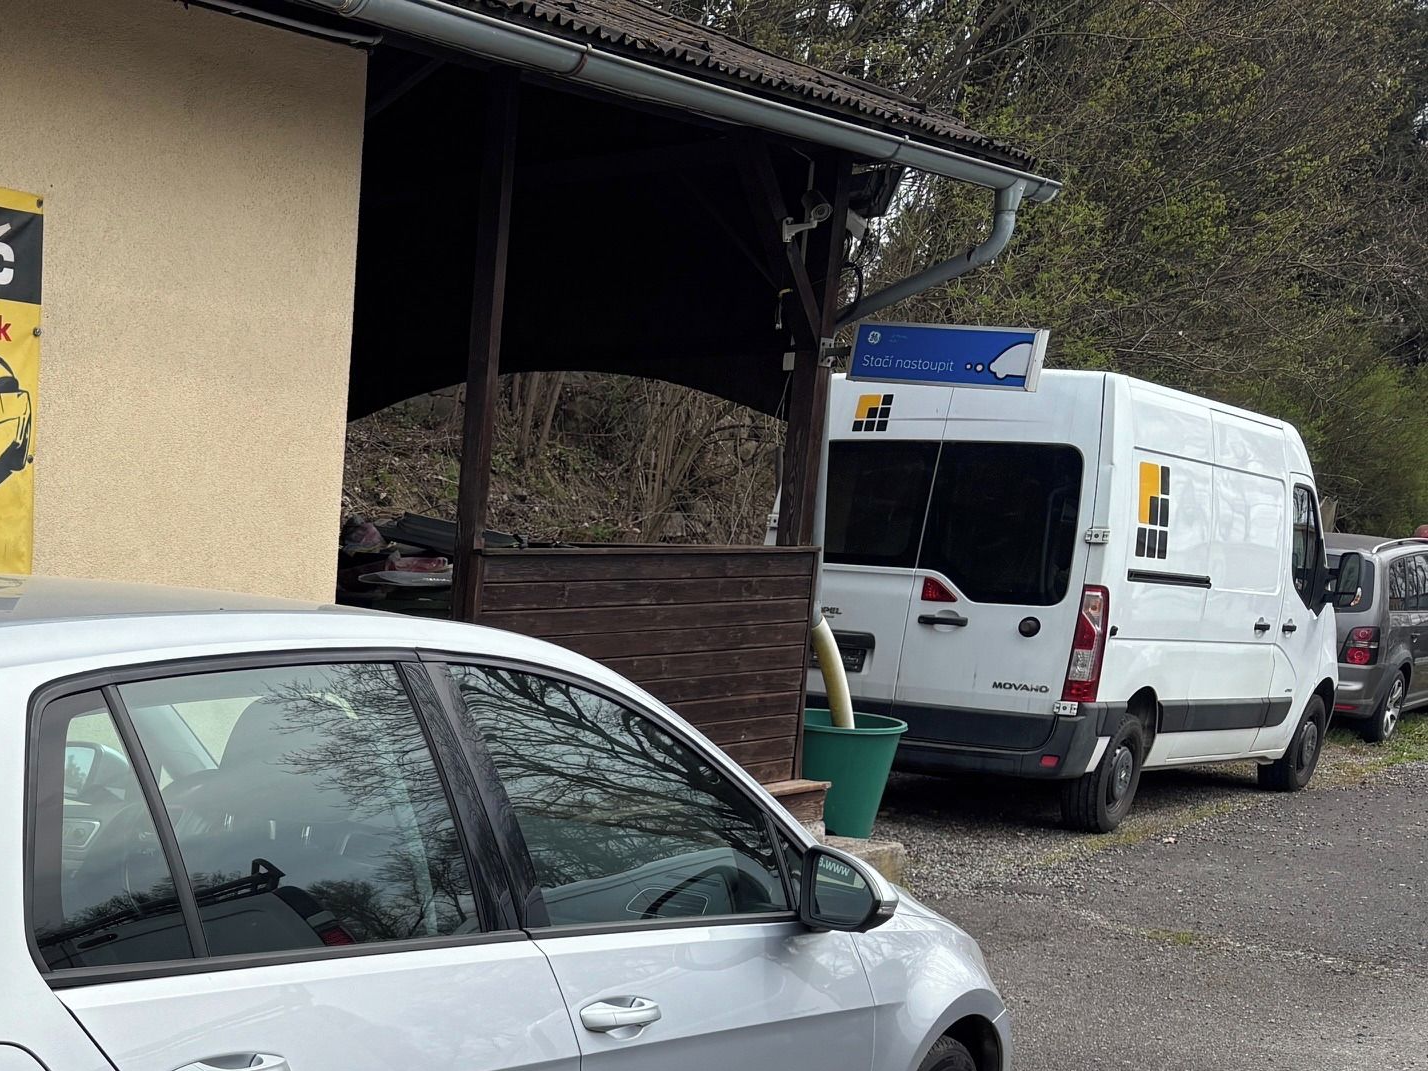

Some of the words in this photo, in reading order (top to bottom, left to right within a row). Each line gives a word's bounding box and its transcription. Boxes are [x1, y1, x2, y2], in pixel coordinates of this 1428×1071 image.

[862, 354, 894, 368] Stačí
[895, 359, 955, 373] nastoupit
[821, 606, 842, 615] PEL
[992, 681, 1050, 693] MOVANO
